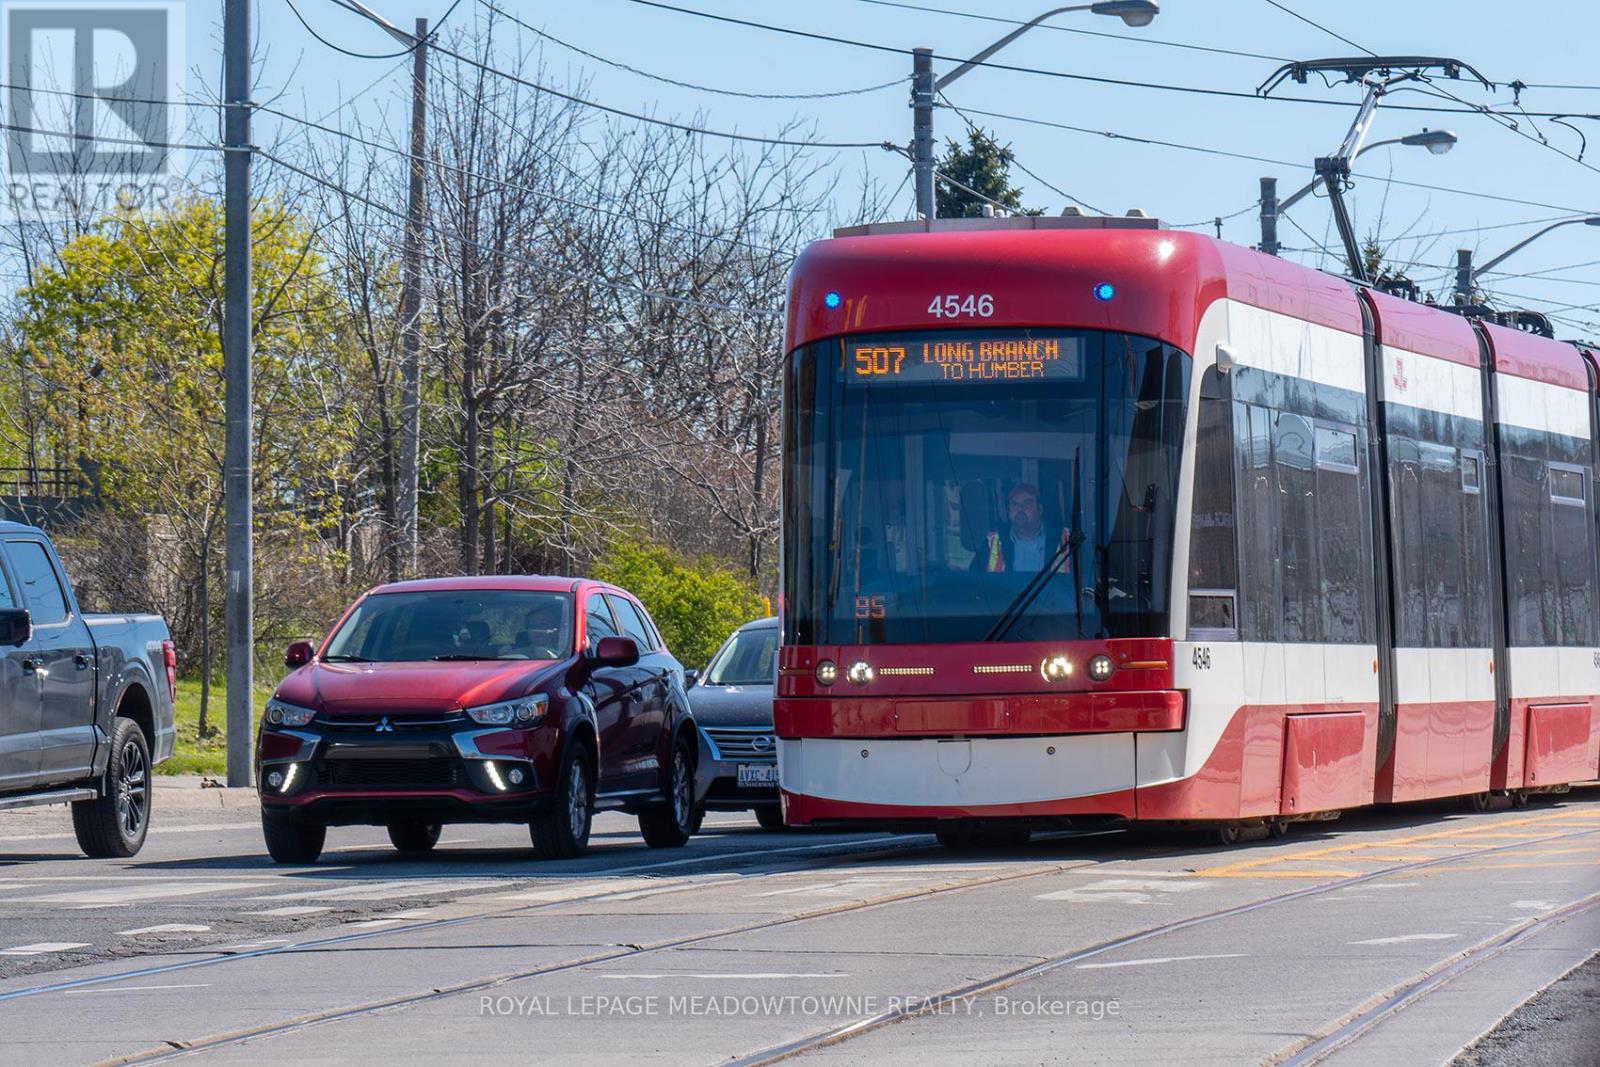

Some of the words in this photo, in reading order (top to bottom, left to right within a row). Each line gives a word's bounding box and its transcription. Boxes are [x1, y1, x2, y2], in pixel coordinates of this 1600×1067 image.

[928, 294, 994, 318] 4546
[855, 347, 905, 375] 507
[923, 342, 974, 364] LONG
[980, 339, 1058, 363] BRANCH
[941, 363, 963, 380] TO
[969, 361, 1044, 379] HUMBER
[855, 595, 886, 619] 95
[1192, 646, 1212, 670] 4546
